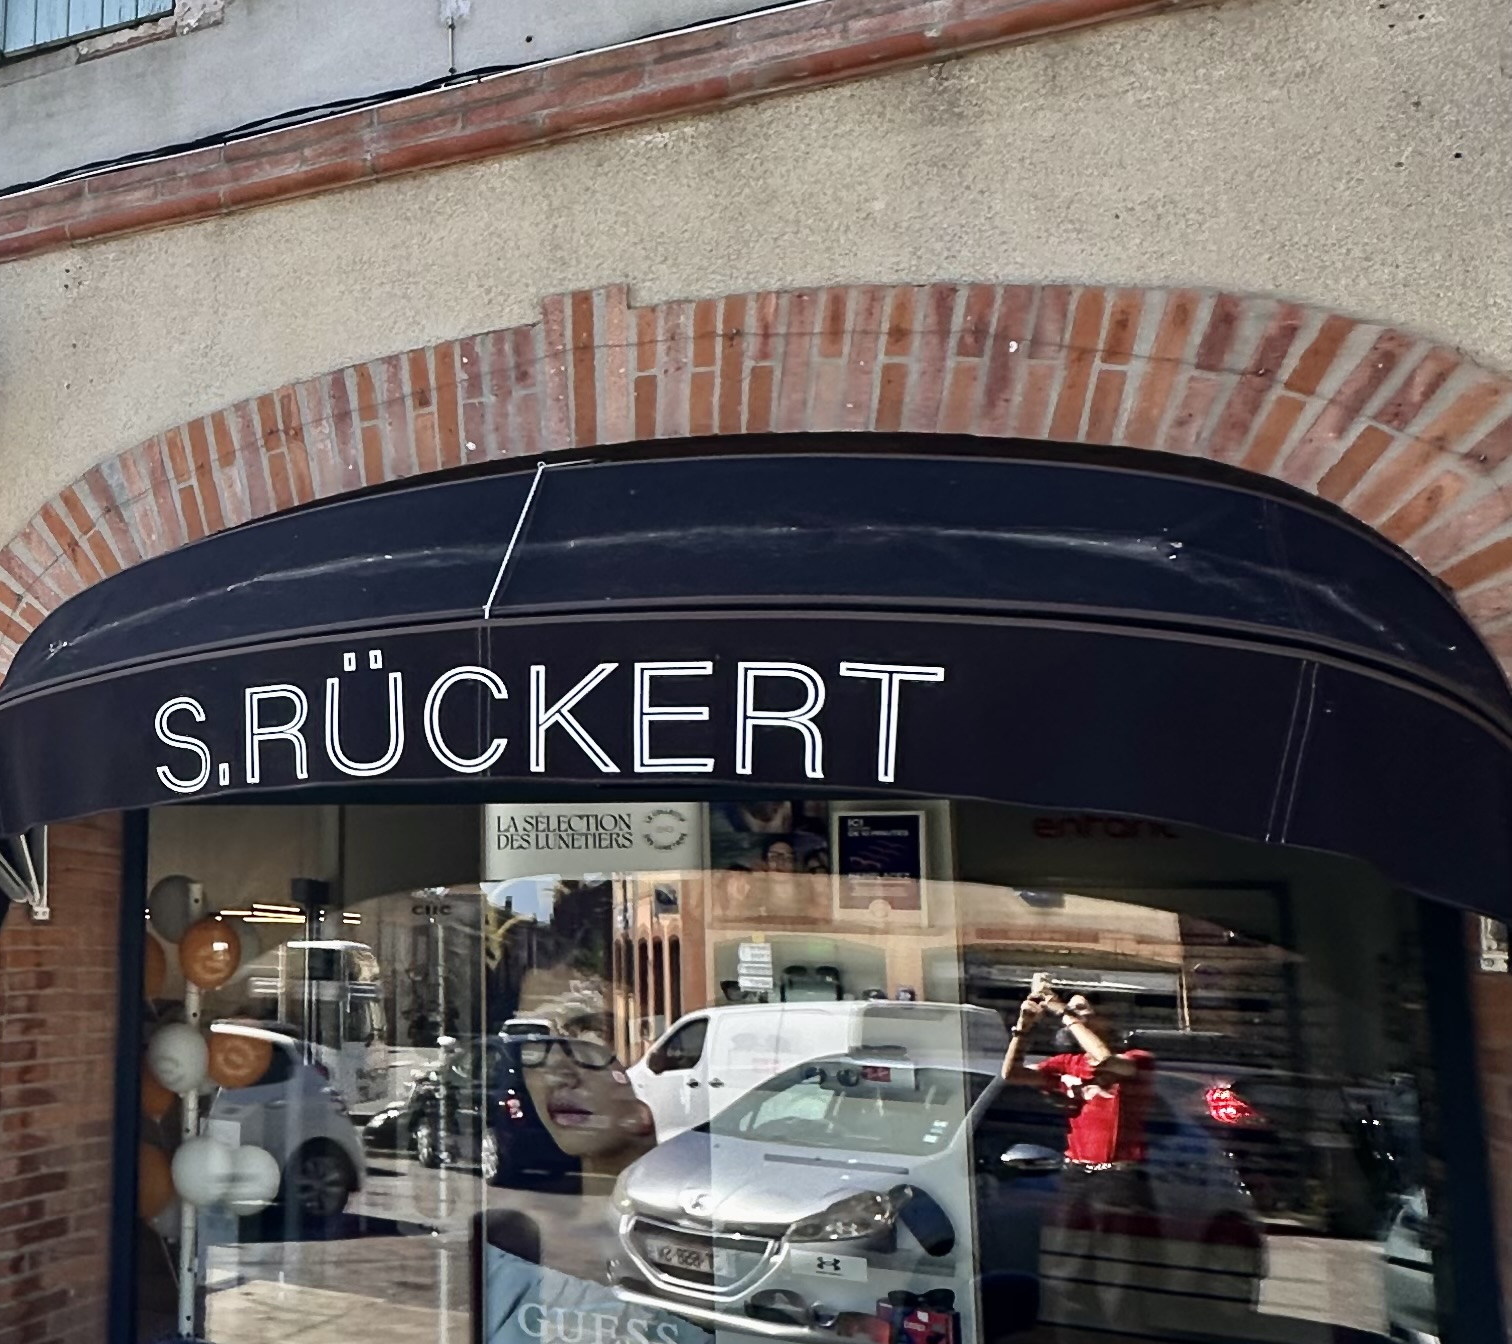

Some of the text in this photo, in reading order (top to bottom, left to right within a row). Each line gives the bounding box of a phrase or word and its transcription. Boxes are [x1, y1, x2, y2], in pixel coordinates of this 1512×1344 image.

[155, 650, 944, 794] S.RÜCKERT
[497, 815, 519, 832] LA
[497, 832, 634, 850] DES LUNETIERS
